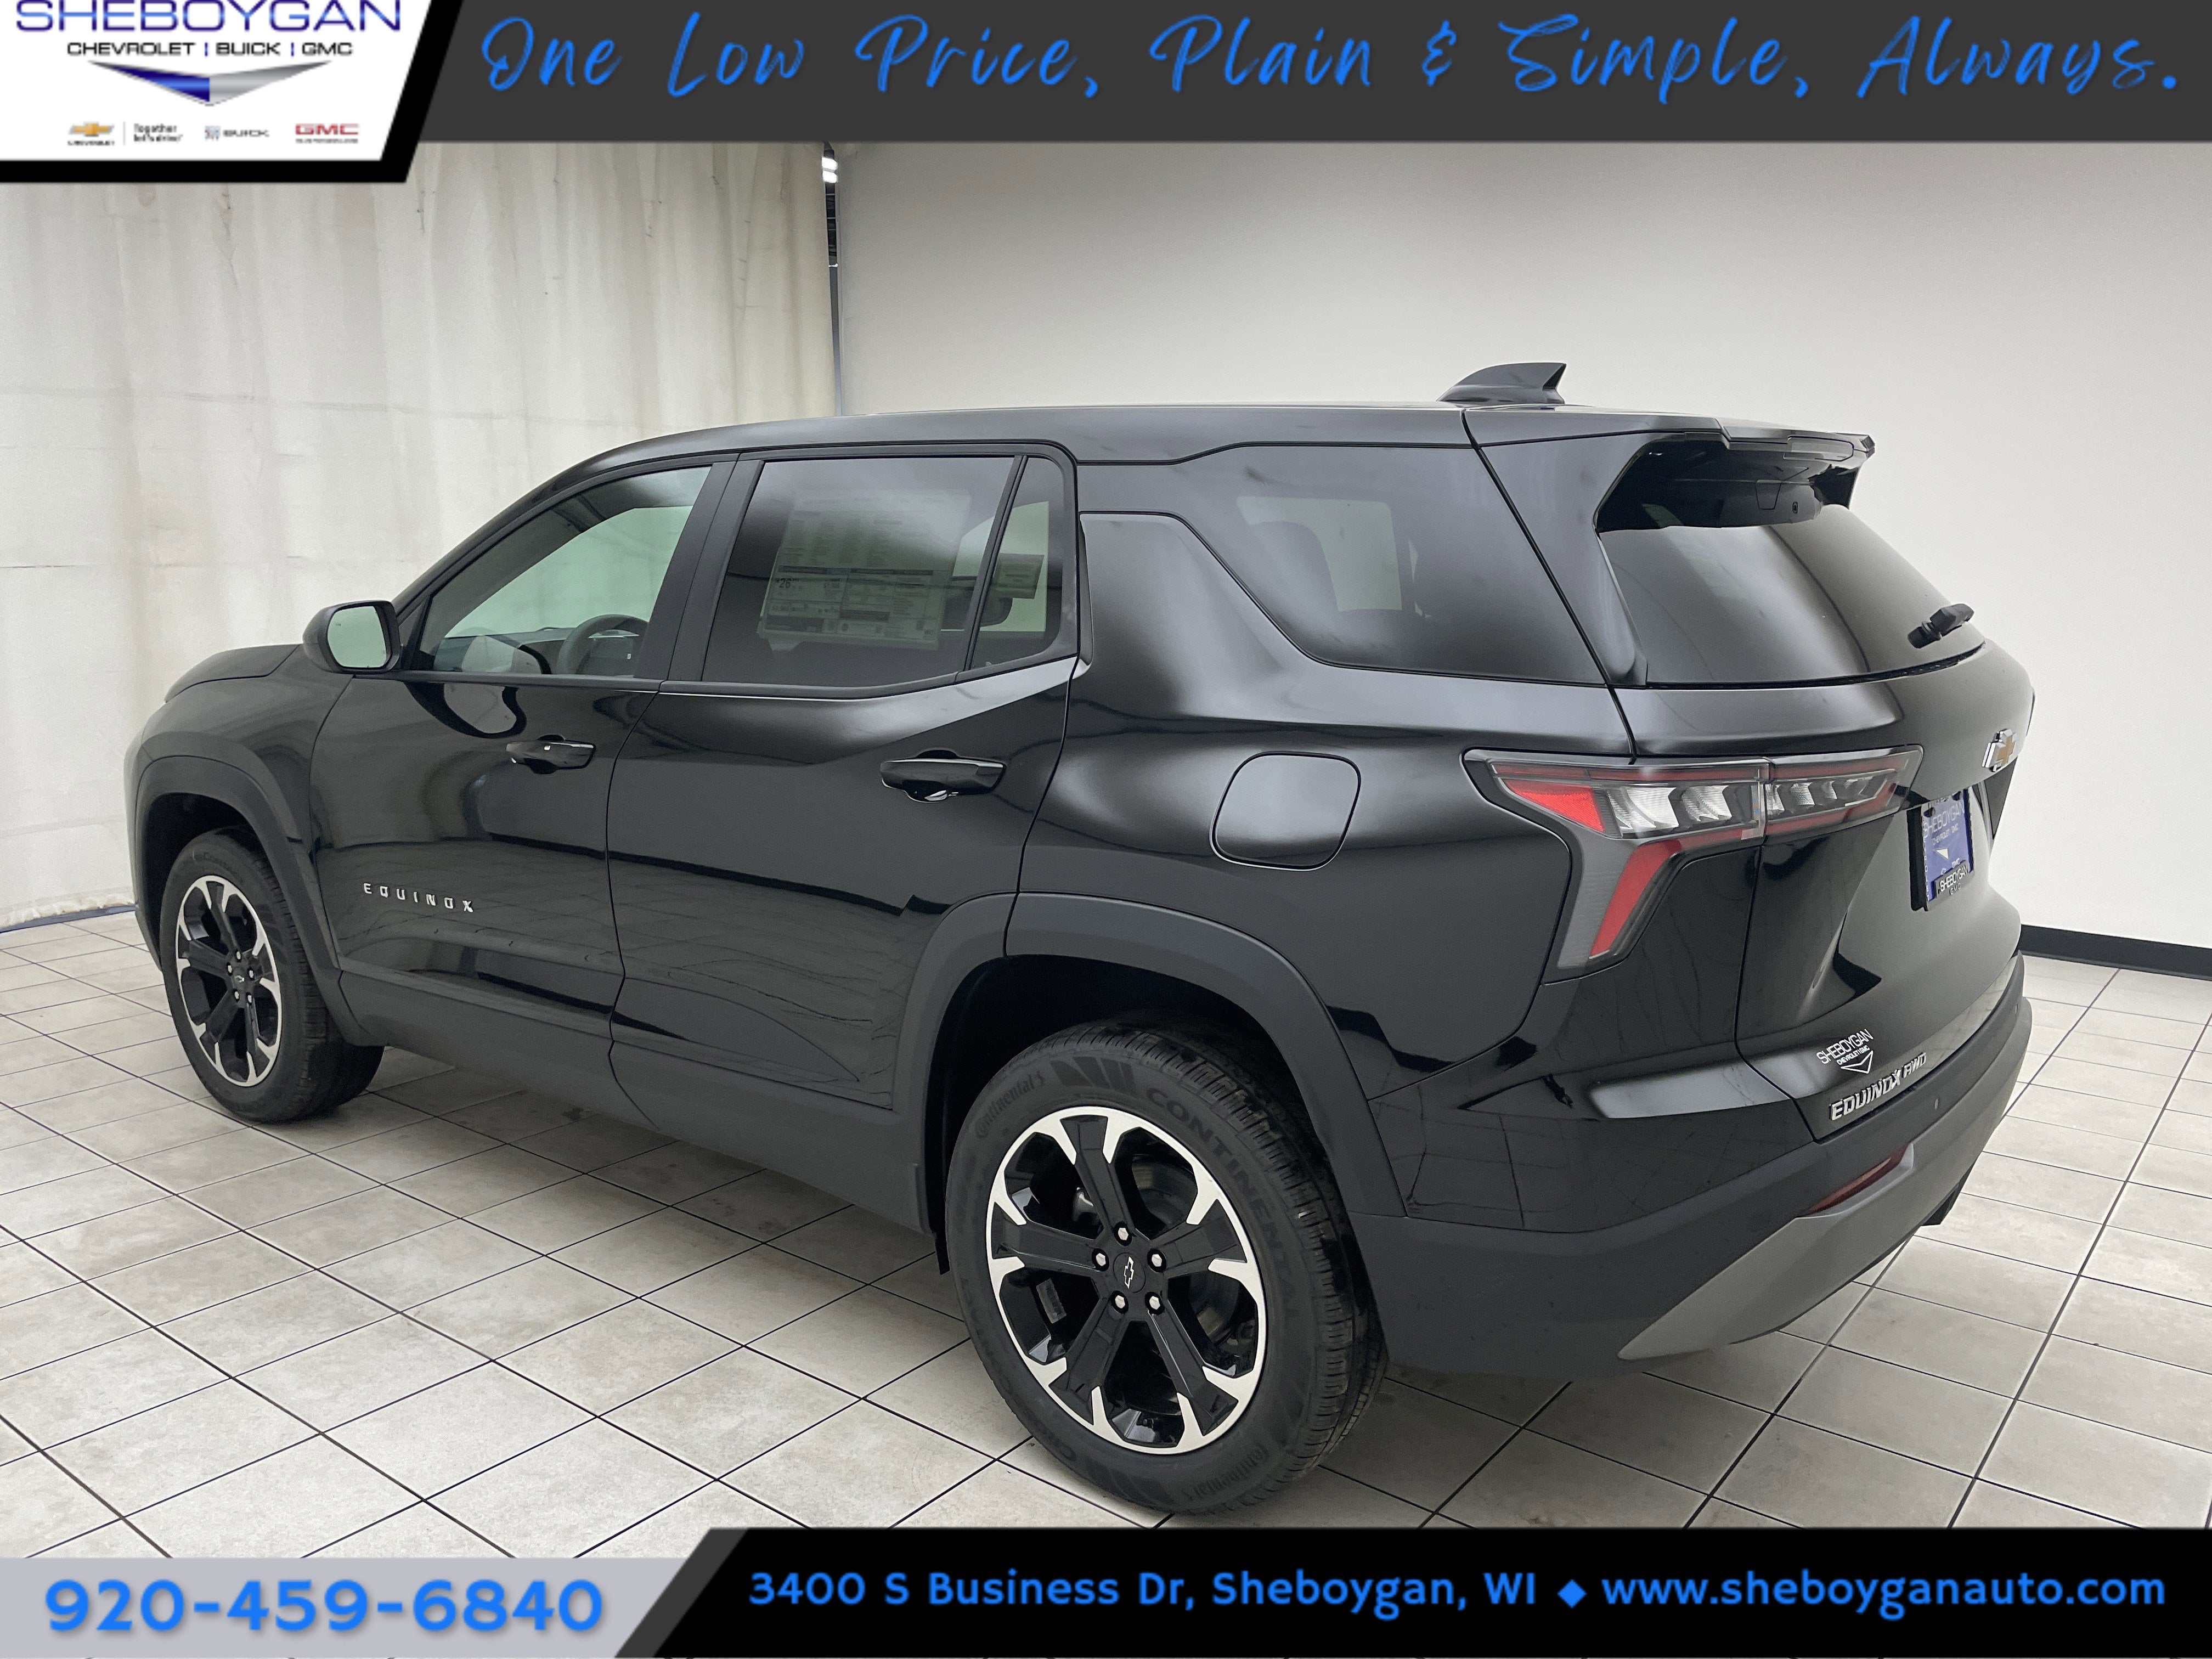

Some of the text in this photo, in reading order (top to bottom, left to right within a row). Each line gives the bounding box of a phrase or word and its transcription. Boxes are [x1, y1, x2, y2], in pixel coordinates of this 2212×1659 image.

[1940, 864, 1968, 892] SHEBOYGAN
[363, 883, 473, 913] EQUINOX
[1816, 1029, 1874, 1064] SHEBOYGAN
[1829, 1052, 1927, 1121] EQUINOX AWD
